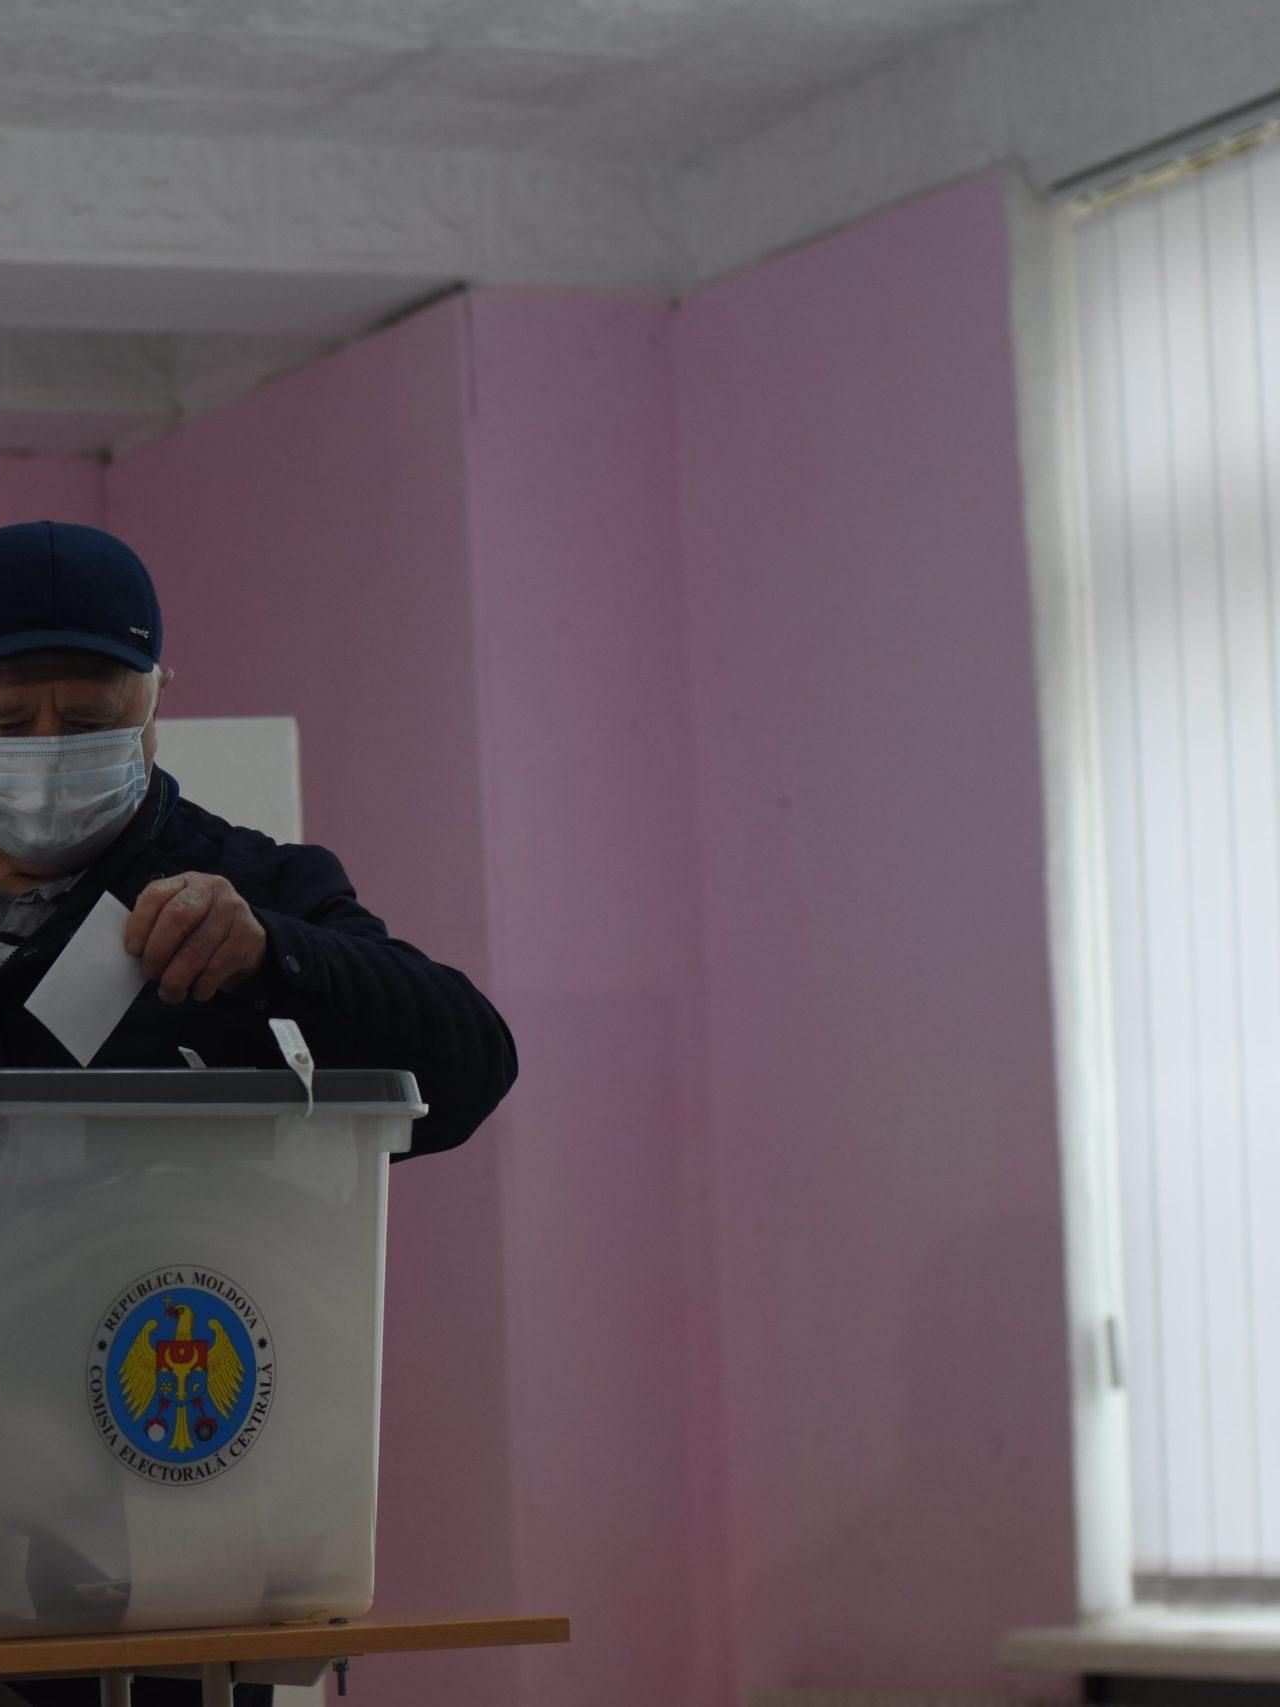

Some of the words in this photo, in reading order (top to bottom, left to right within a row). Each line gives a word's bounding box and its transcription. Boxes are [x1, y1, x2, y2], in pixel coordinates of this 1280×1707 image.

[104, 1271, 185, 1332] REPUBLICA
[192, 1271, 259, 1330] MOLDOVA
[89, 1364, 119, 1447] COMISIA
[119, 1445, 228, 1482] ELECTORALĂ
[230, 1362, 273, 1457] CENTRALĂ
